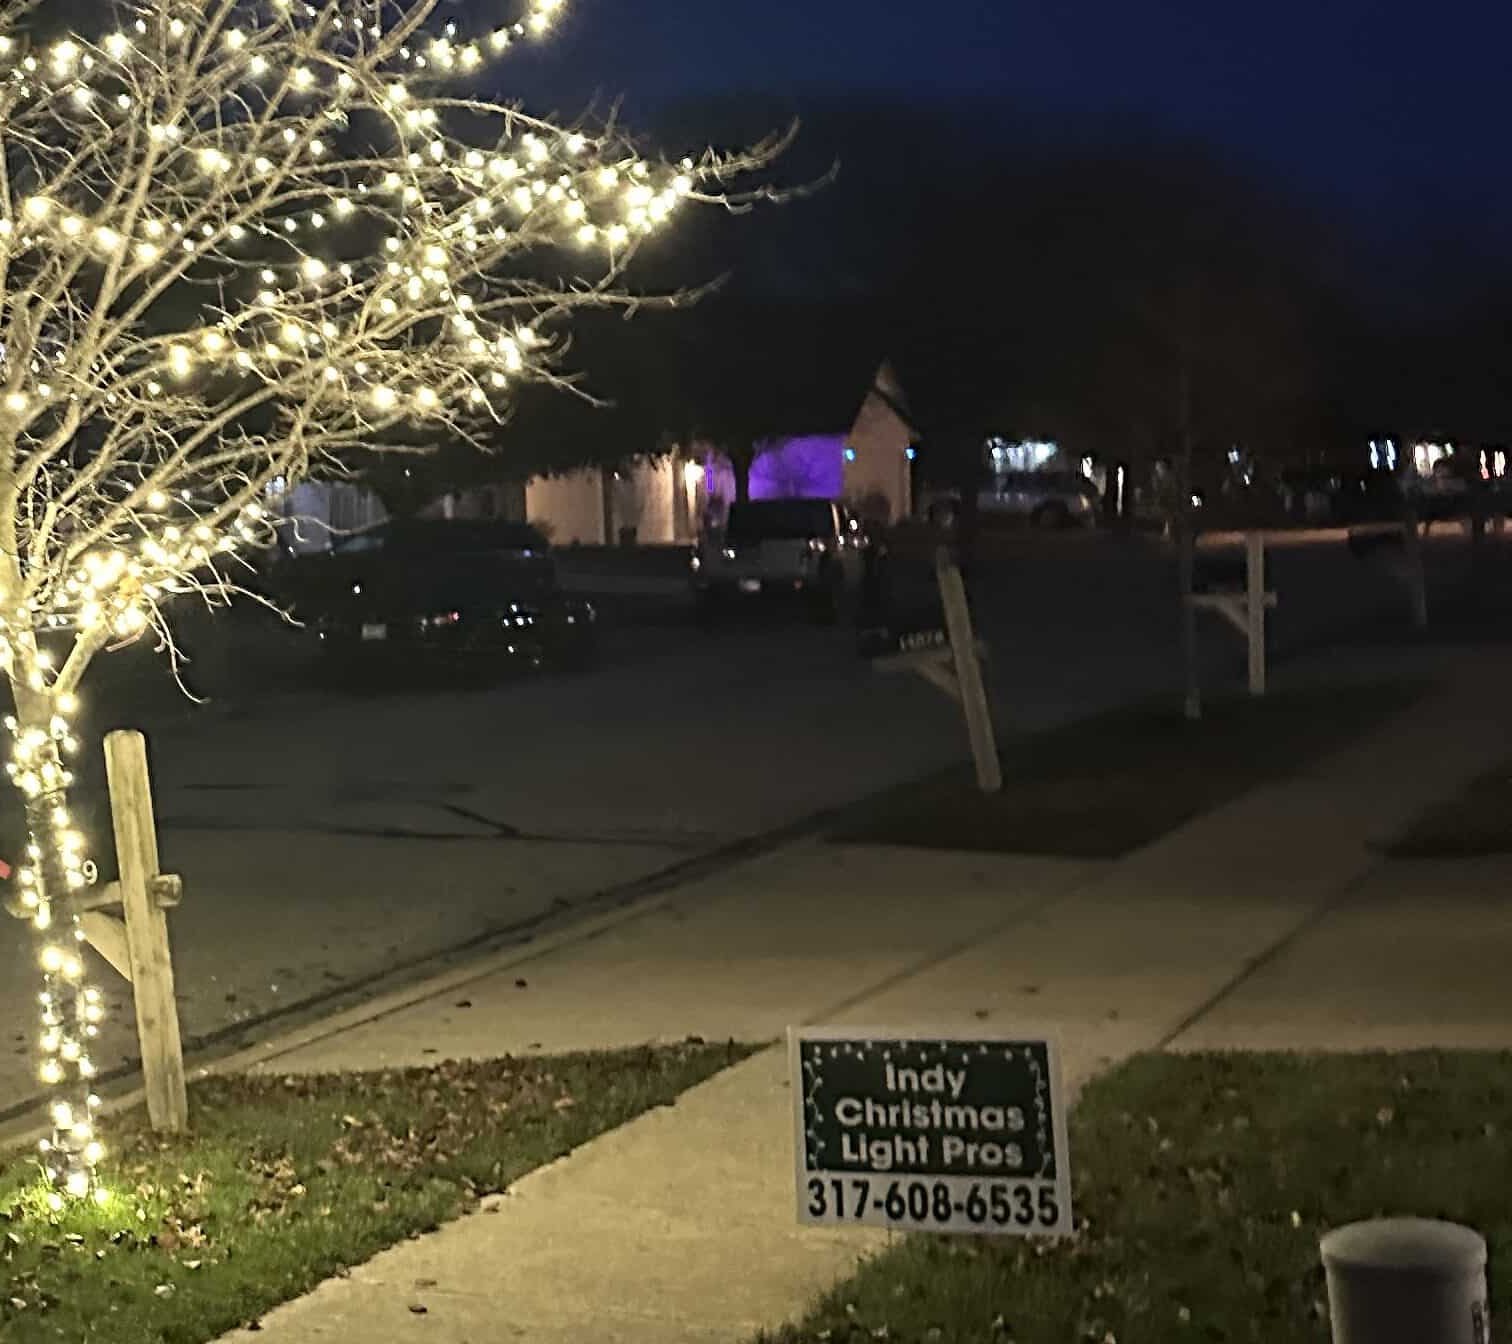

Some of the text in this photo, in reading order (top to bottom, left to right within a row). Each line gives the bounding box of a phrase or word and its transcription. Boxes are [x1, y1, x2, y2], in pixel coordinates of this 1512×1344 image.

[886, 1063, 966, 1096] Indy
[835, 1097, 1024, 1130] Christmas
[841, 1133, 1023, 1169] Light Pros
[808, 1179, 1058, 1226] 317-608-6535
